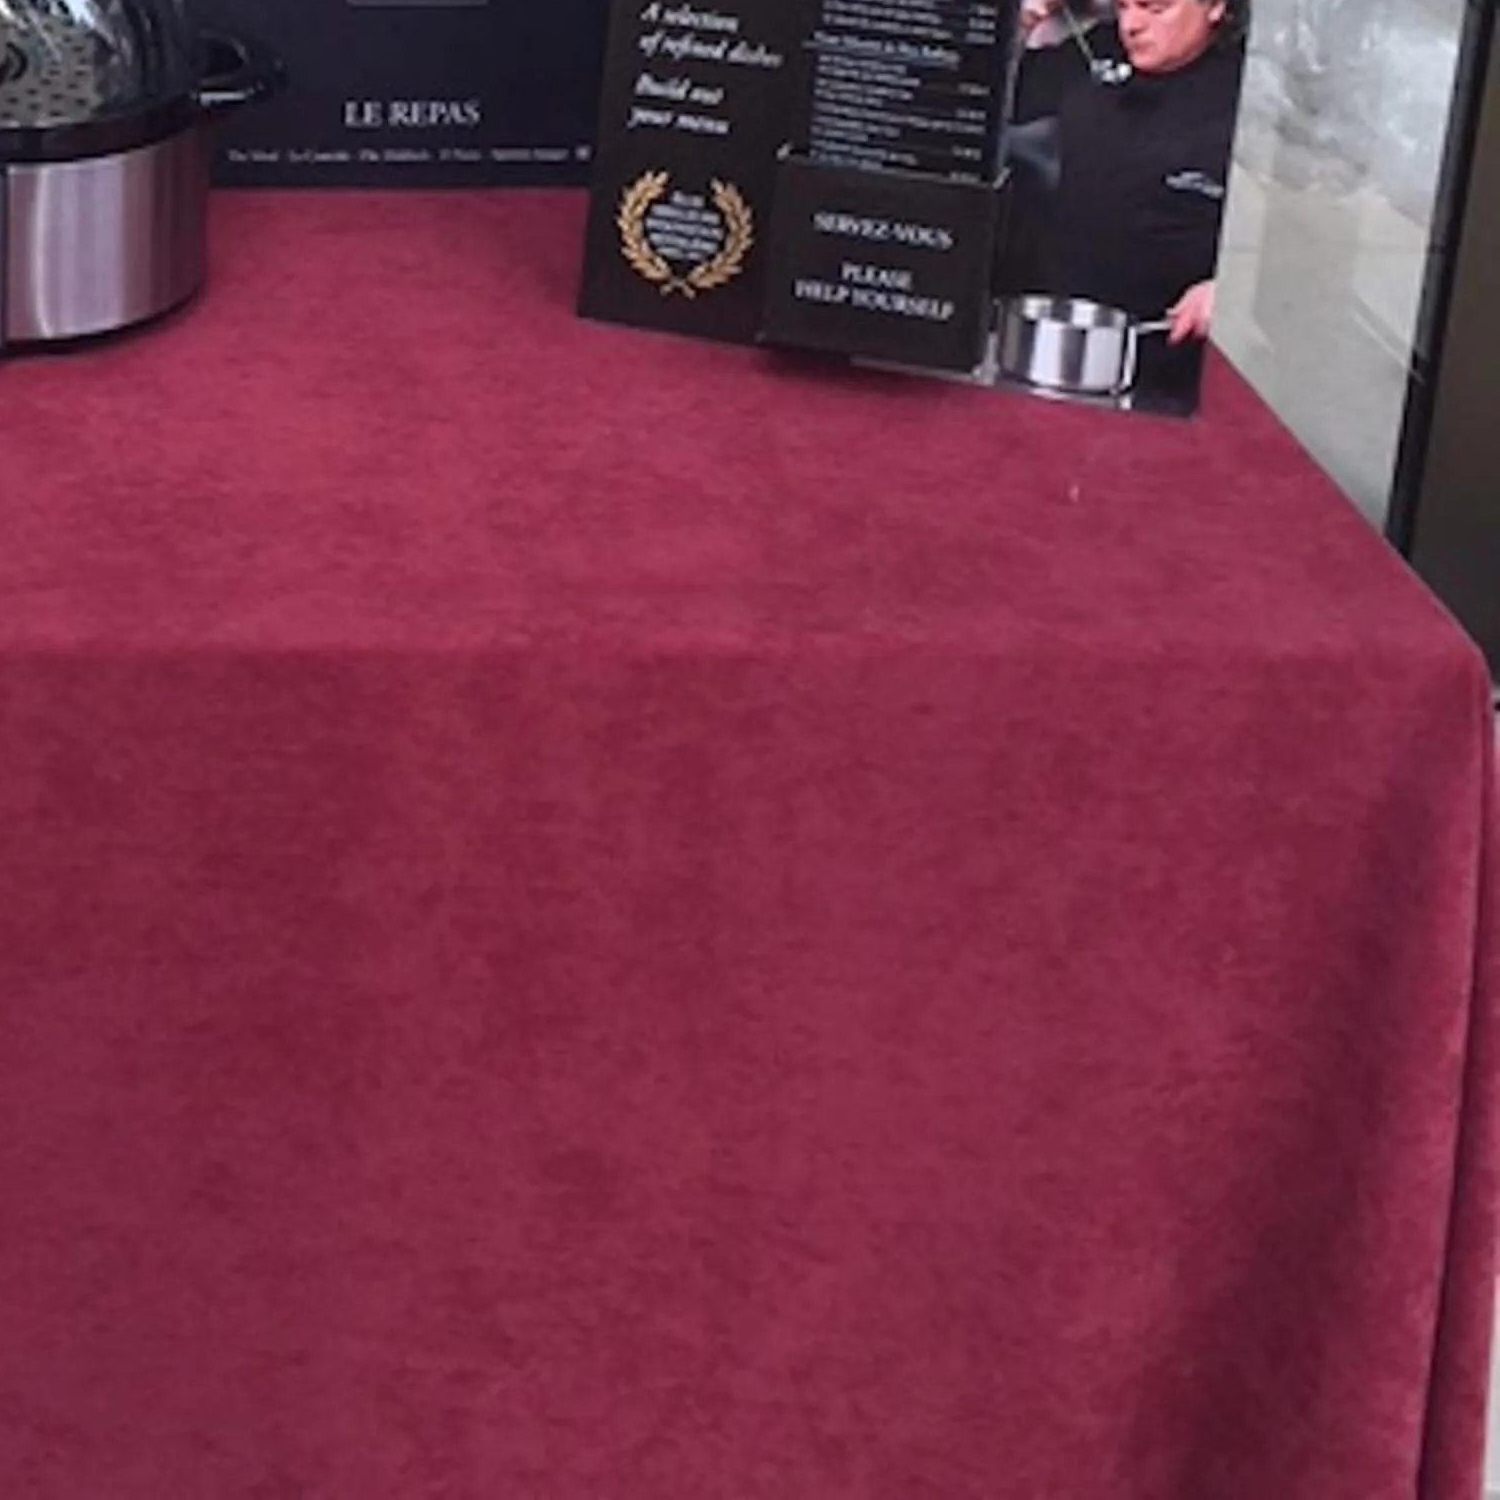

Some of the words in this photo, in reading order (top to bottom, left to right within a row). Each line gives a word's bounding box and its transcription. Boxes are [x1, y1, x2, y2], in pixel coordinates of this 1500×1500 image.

[662, 4, 739, 33] selection
[344, 102, 383, 126] LE
[388, 101, 480, 126] REPAS
[675, 114, 730, 135] menu
